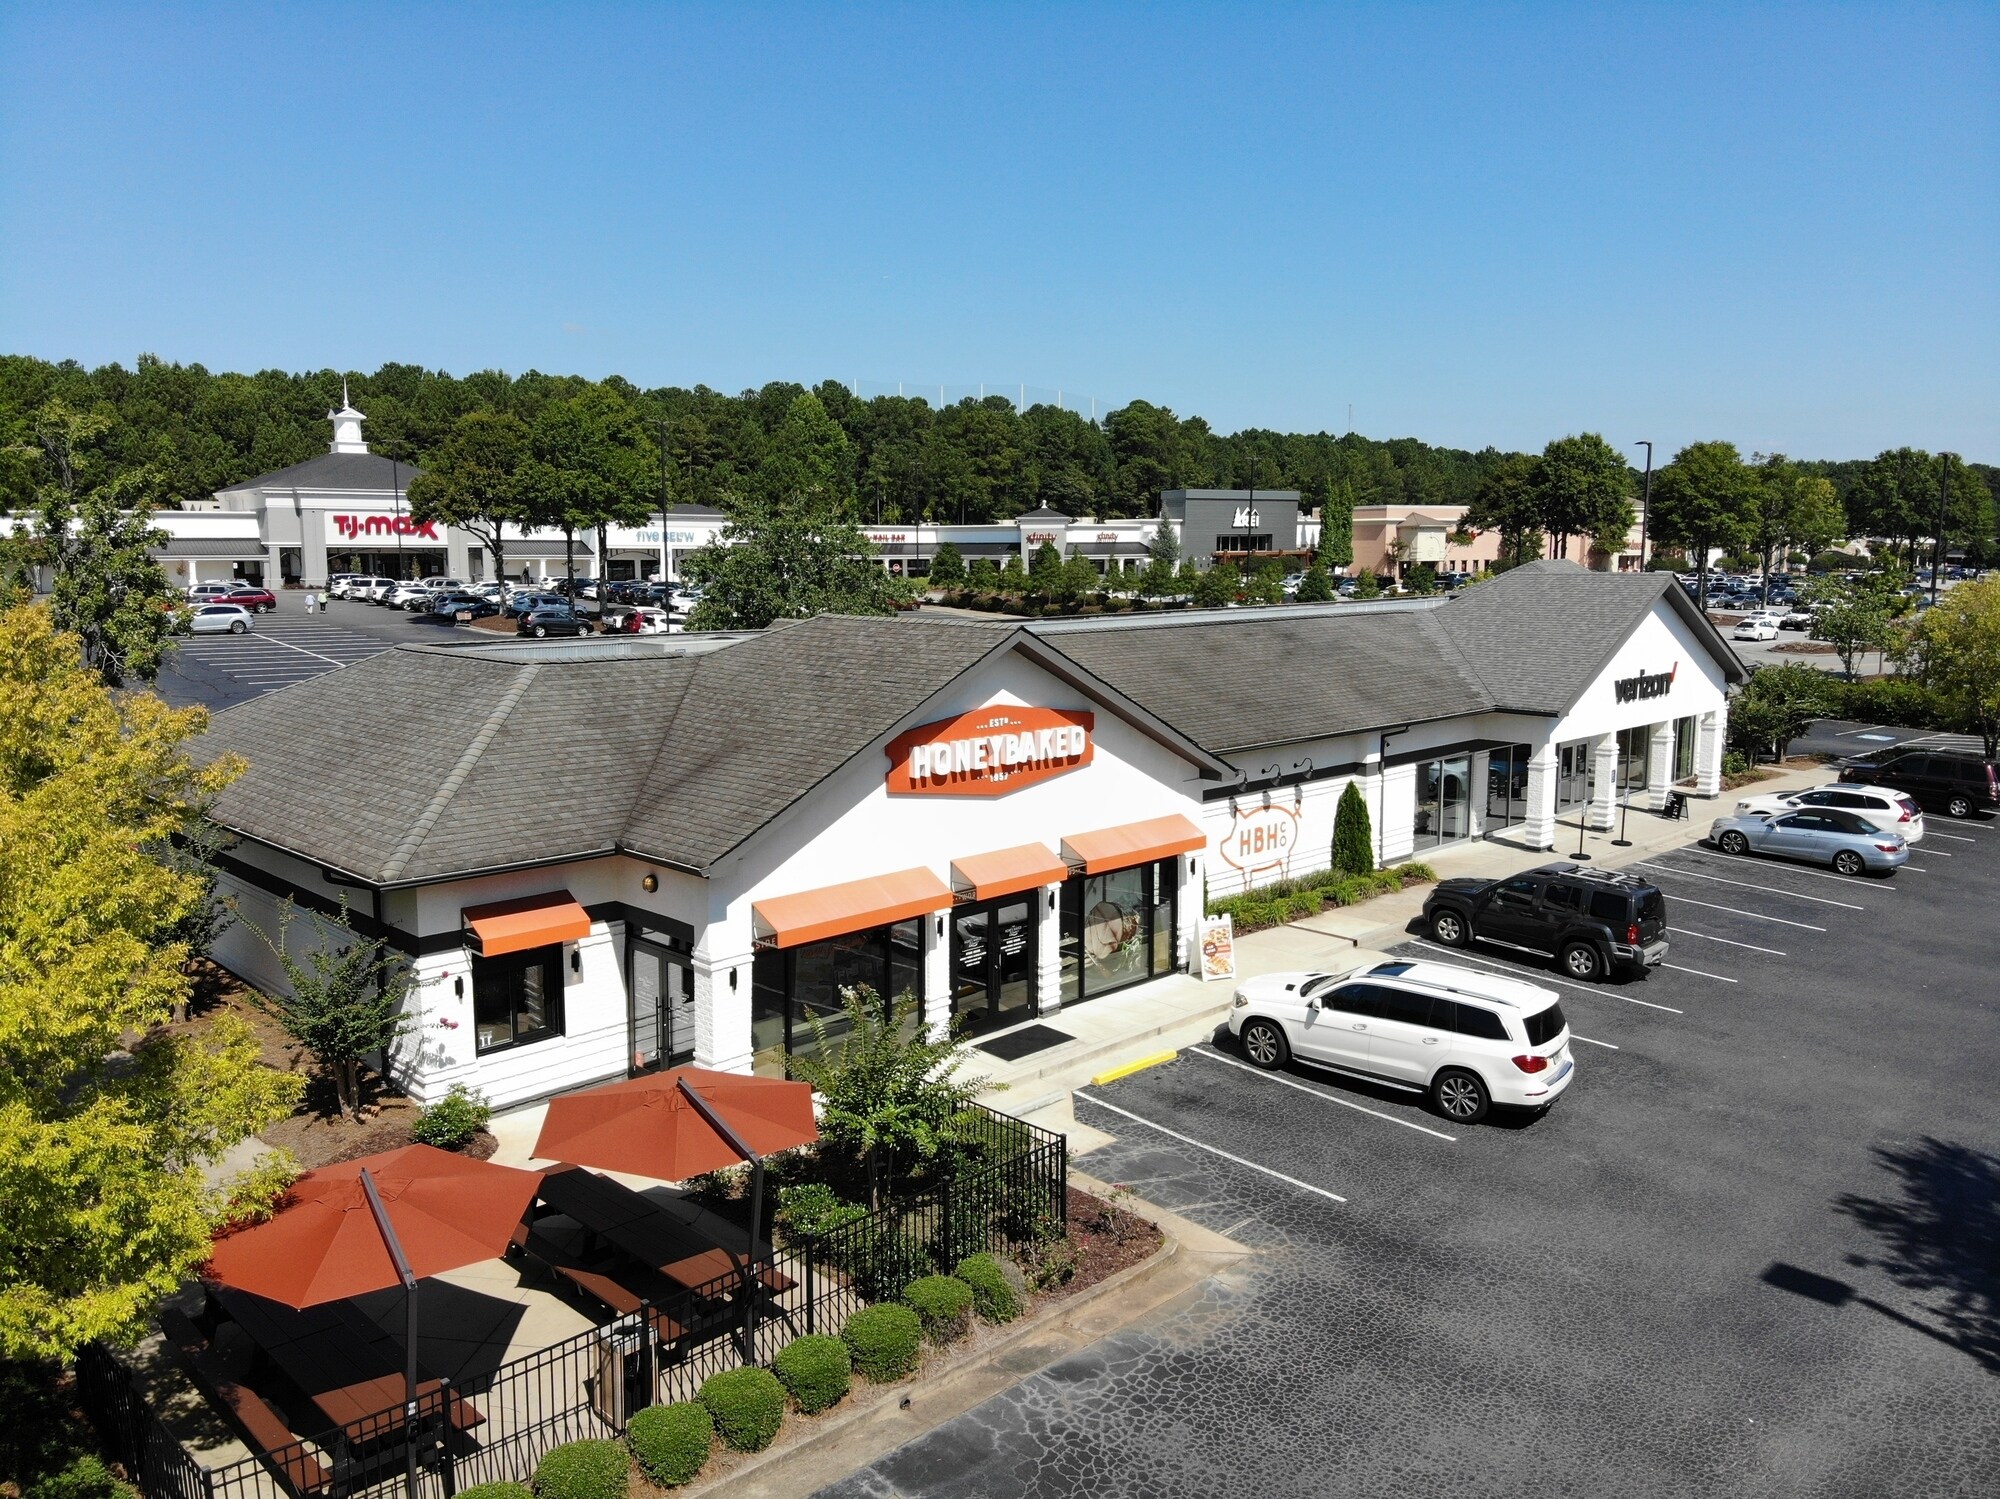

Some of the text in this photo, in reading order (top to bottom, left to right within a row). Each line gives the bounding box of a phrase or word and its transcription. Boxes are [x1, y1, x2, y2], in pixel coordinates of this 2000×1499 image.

[636, 530, 659, 542] five
[1614, 669, 1674, 705] verizon
[909, 725, 1086, 780] HONEYBAKED
[990, 771, 1009, 782] 1957
[1240, 822, 1278, 857] HBH
